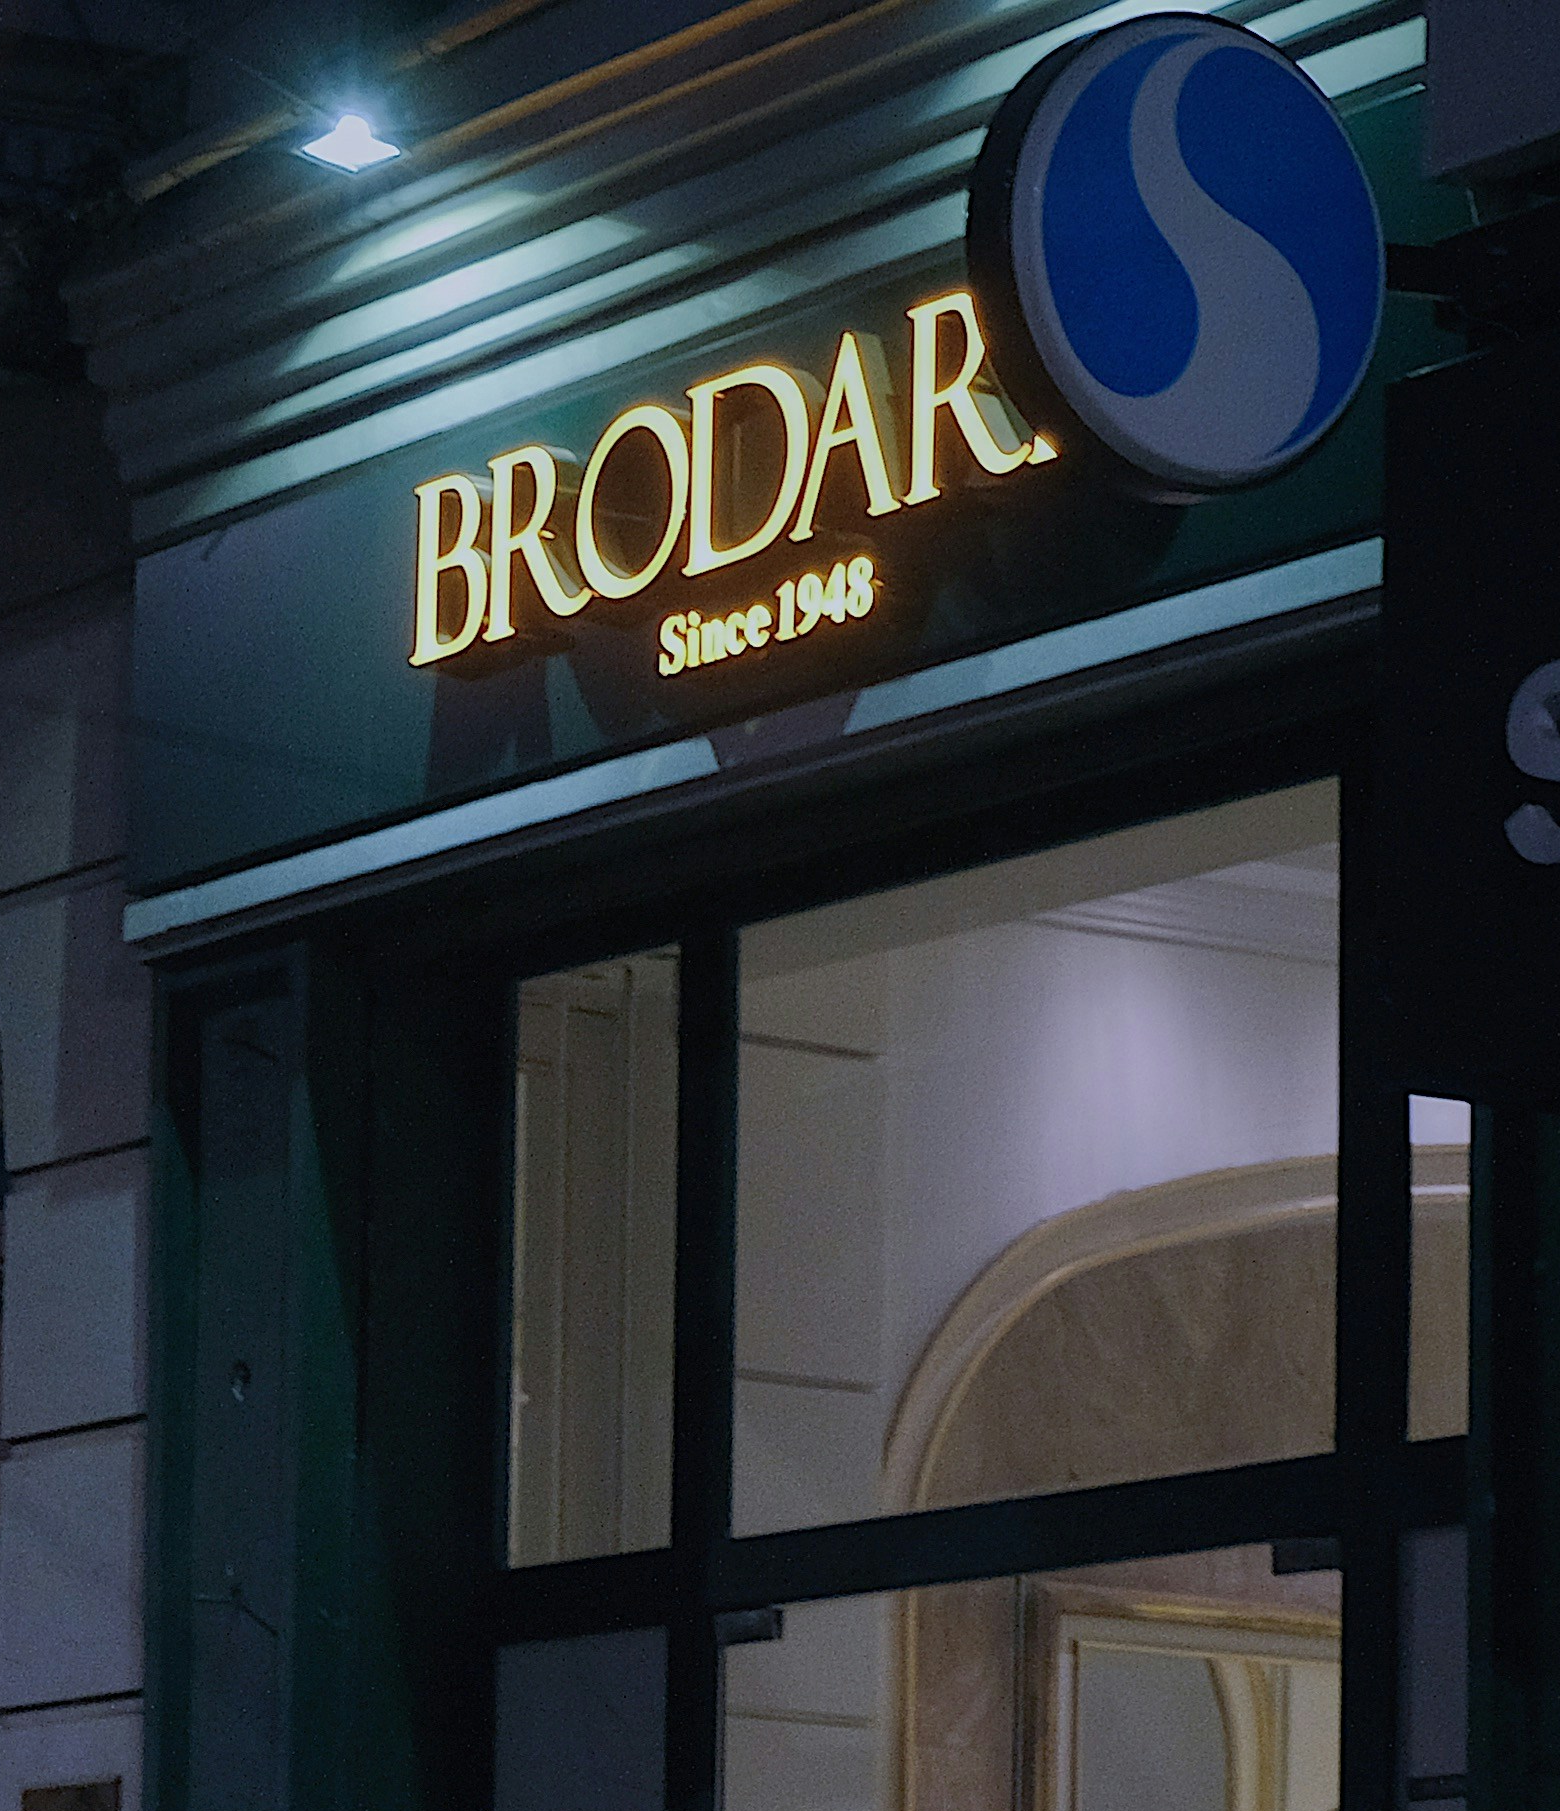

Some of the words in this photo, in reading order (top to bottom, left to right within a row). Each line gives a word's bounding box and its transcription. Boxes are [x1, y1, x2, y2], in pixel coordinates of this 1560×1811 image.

[409, 291, 1063, 668] BRODAR
[657, 598, 775, 678] Since
[772, 554, 878, 645] 1948
